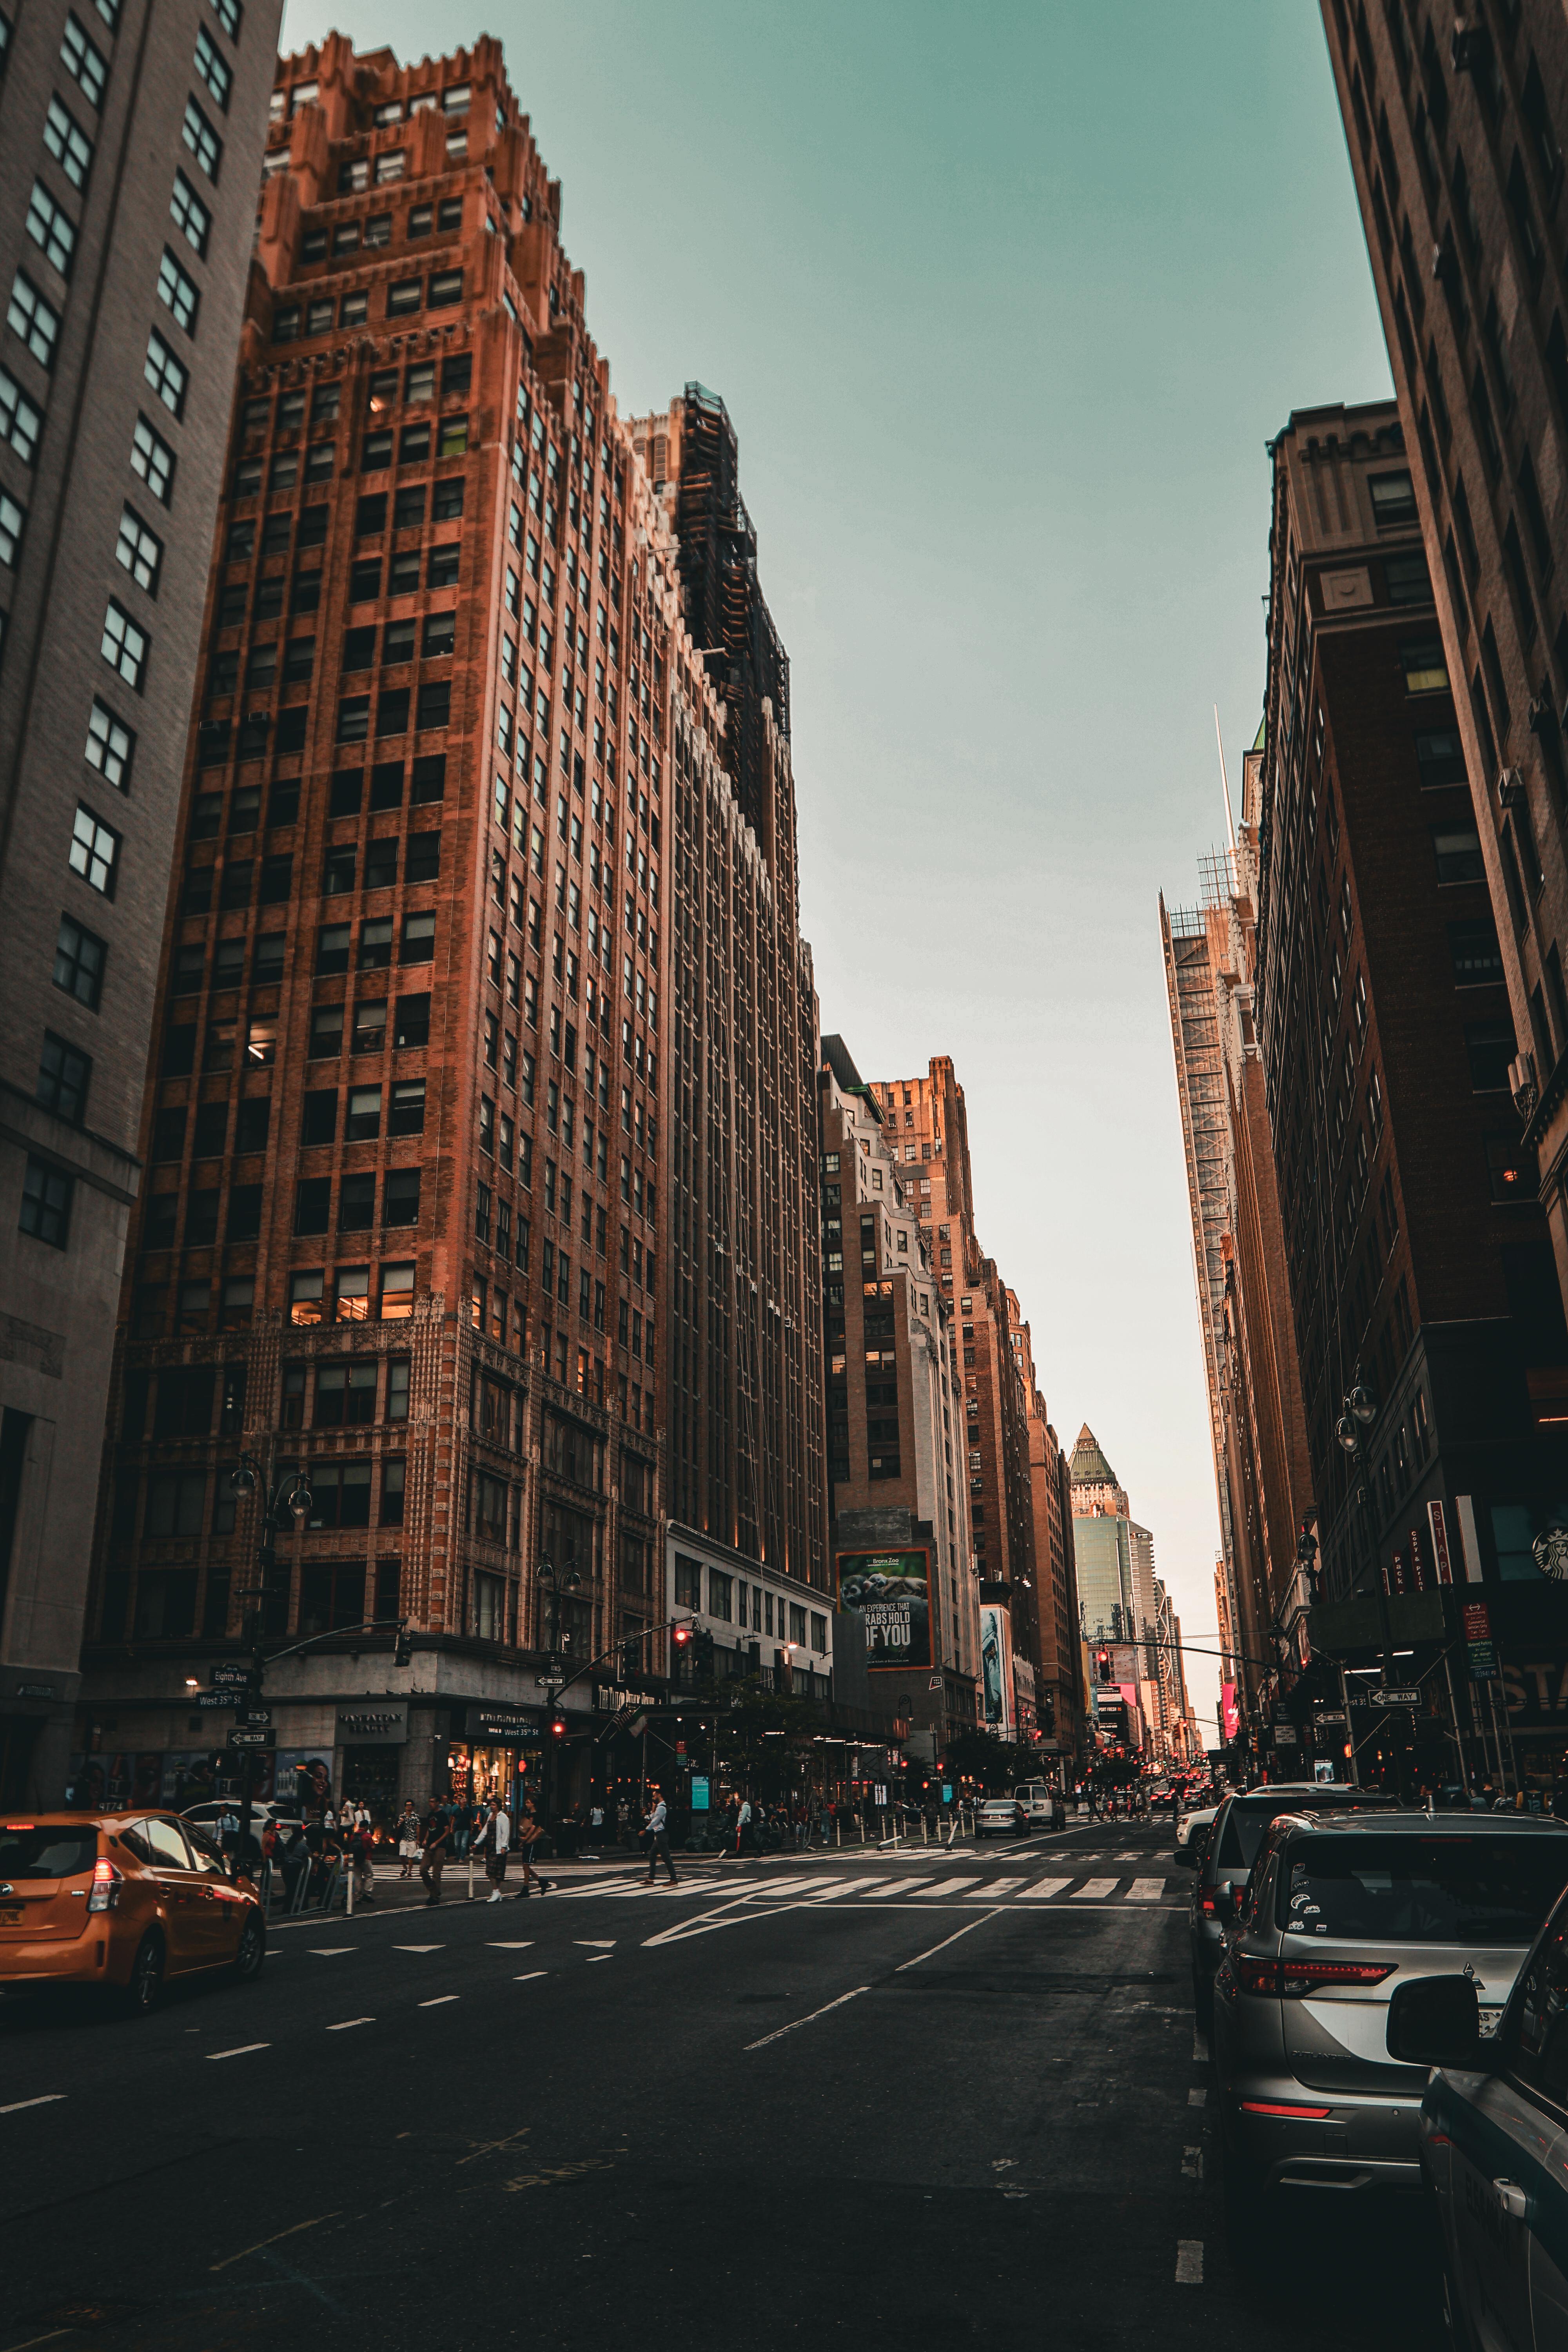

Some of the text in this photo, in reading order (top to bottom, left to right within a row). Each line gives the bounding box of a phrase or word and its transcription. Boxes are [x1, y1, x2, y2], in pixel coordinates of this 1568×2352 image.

[1395, 1557, 1403, 1584] Pack
[859, 1602, 910, 1613] AN EXPERIENCE THAT
[866, 1612, 910, 1625] RABS HOLD
[881, 1624, 911, 1646] YOU
[215, 1671, 248, 1683] Eighth Ave
[200, 1696, 218, 1705] West
[233, 1695, 241, 1704] St
[599, 1685, 608, 1710] THE
[338, 1714, 402, 1722] MANHATTAN
[1528, 1799, 1541, 1812] 12
[1292, 2051, 1351, 2061] OUTLANDER
